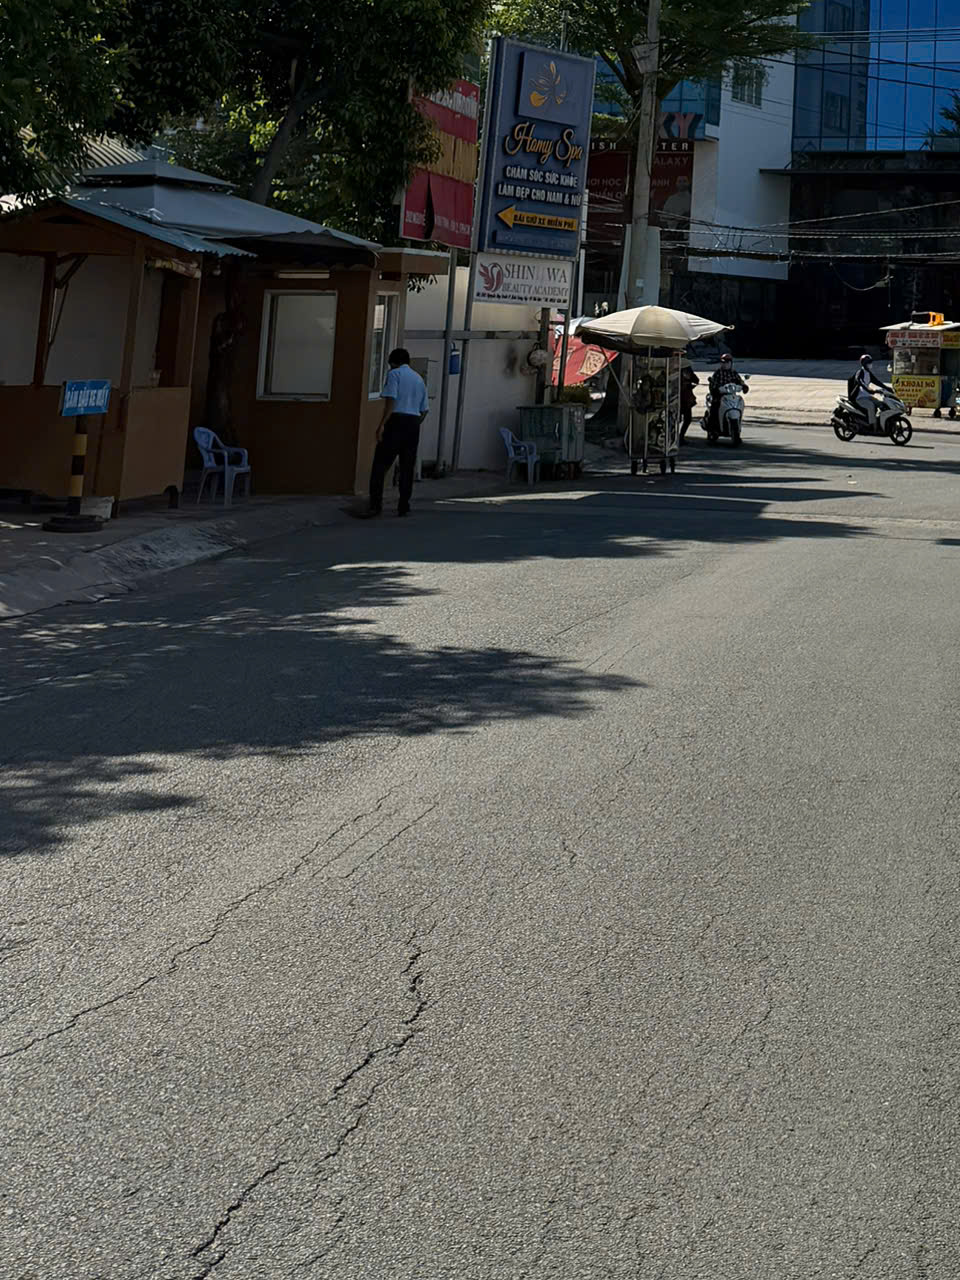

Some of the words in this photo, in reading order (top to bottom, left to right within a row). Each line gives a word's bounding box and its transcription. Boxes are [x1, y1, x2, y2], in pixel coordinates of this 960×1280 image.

[555, 128, 584, 169] Spa
[530, 188, 546, 201] CHO
[546, 191, 563, 204] NAM
